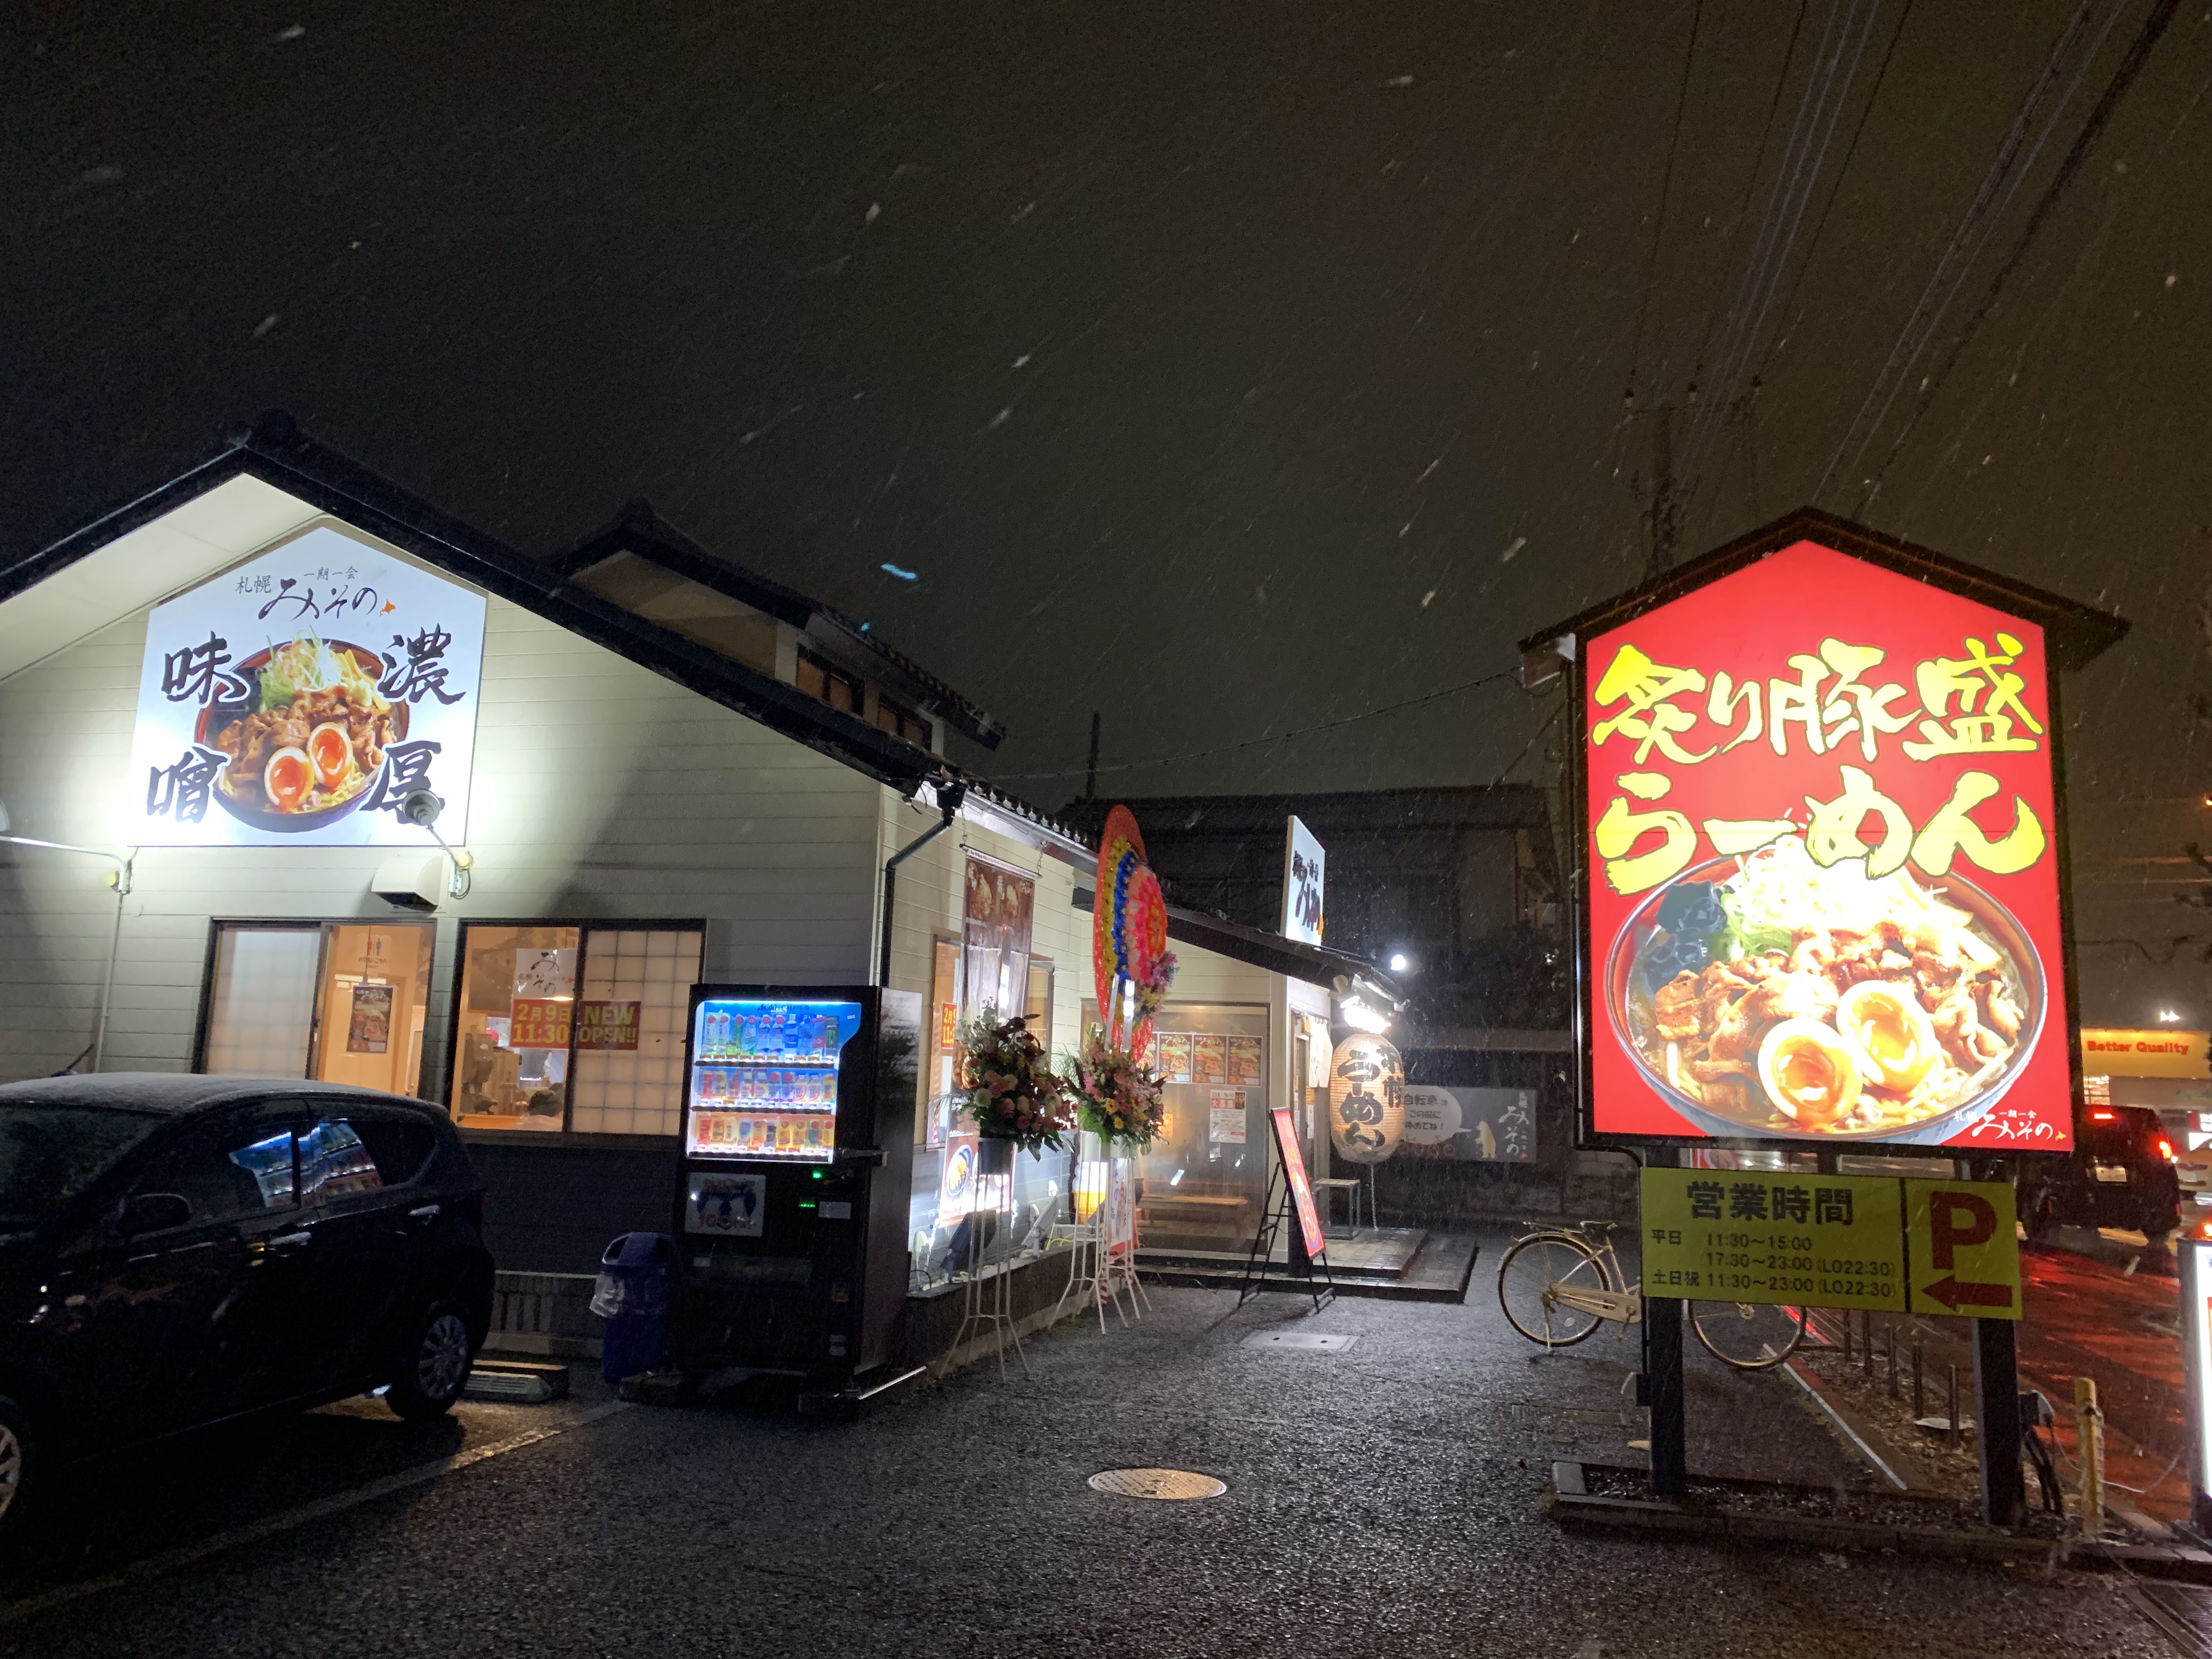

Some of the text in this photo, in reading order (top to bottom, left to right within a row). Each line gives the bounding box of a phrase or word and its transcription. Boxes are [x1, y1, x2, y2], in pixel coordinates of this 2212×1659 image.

[303, 565, 358, 580] 一期一会
[235, 575, 272, 595] 札幌
[258, 578, 377, 622] みその
[1592, 632, 2045, 765] 炙り豚盛
[1594, 765, 2049, 896] らーめん
[517, 1003, 571, 1022] 2月9日
[584, 1006, 635, 1025] NEW
[513, 1023, 571, 1044] 11:30
[578, 1026, 637, 1043] OPEN!!
[2087, 1041, 2189, 1055] Better Quality
[1337, 1049, 1386, 1148] らーめん
[1954, 1110, 1979, 1123] 札幌
[1999, 1109, 2037, 1119] 一期一会
[1971, 1114, 2053, 1141] みその
[1686, 1180, 1854, 1227] 営業時間
[1651, 1228, 1683, 1246] 平日
[1929, 1190, 1997, 1271] P
[1651, 1269, 1701, 1287] 土日祝
